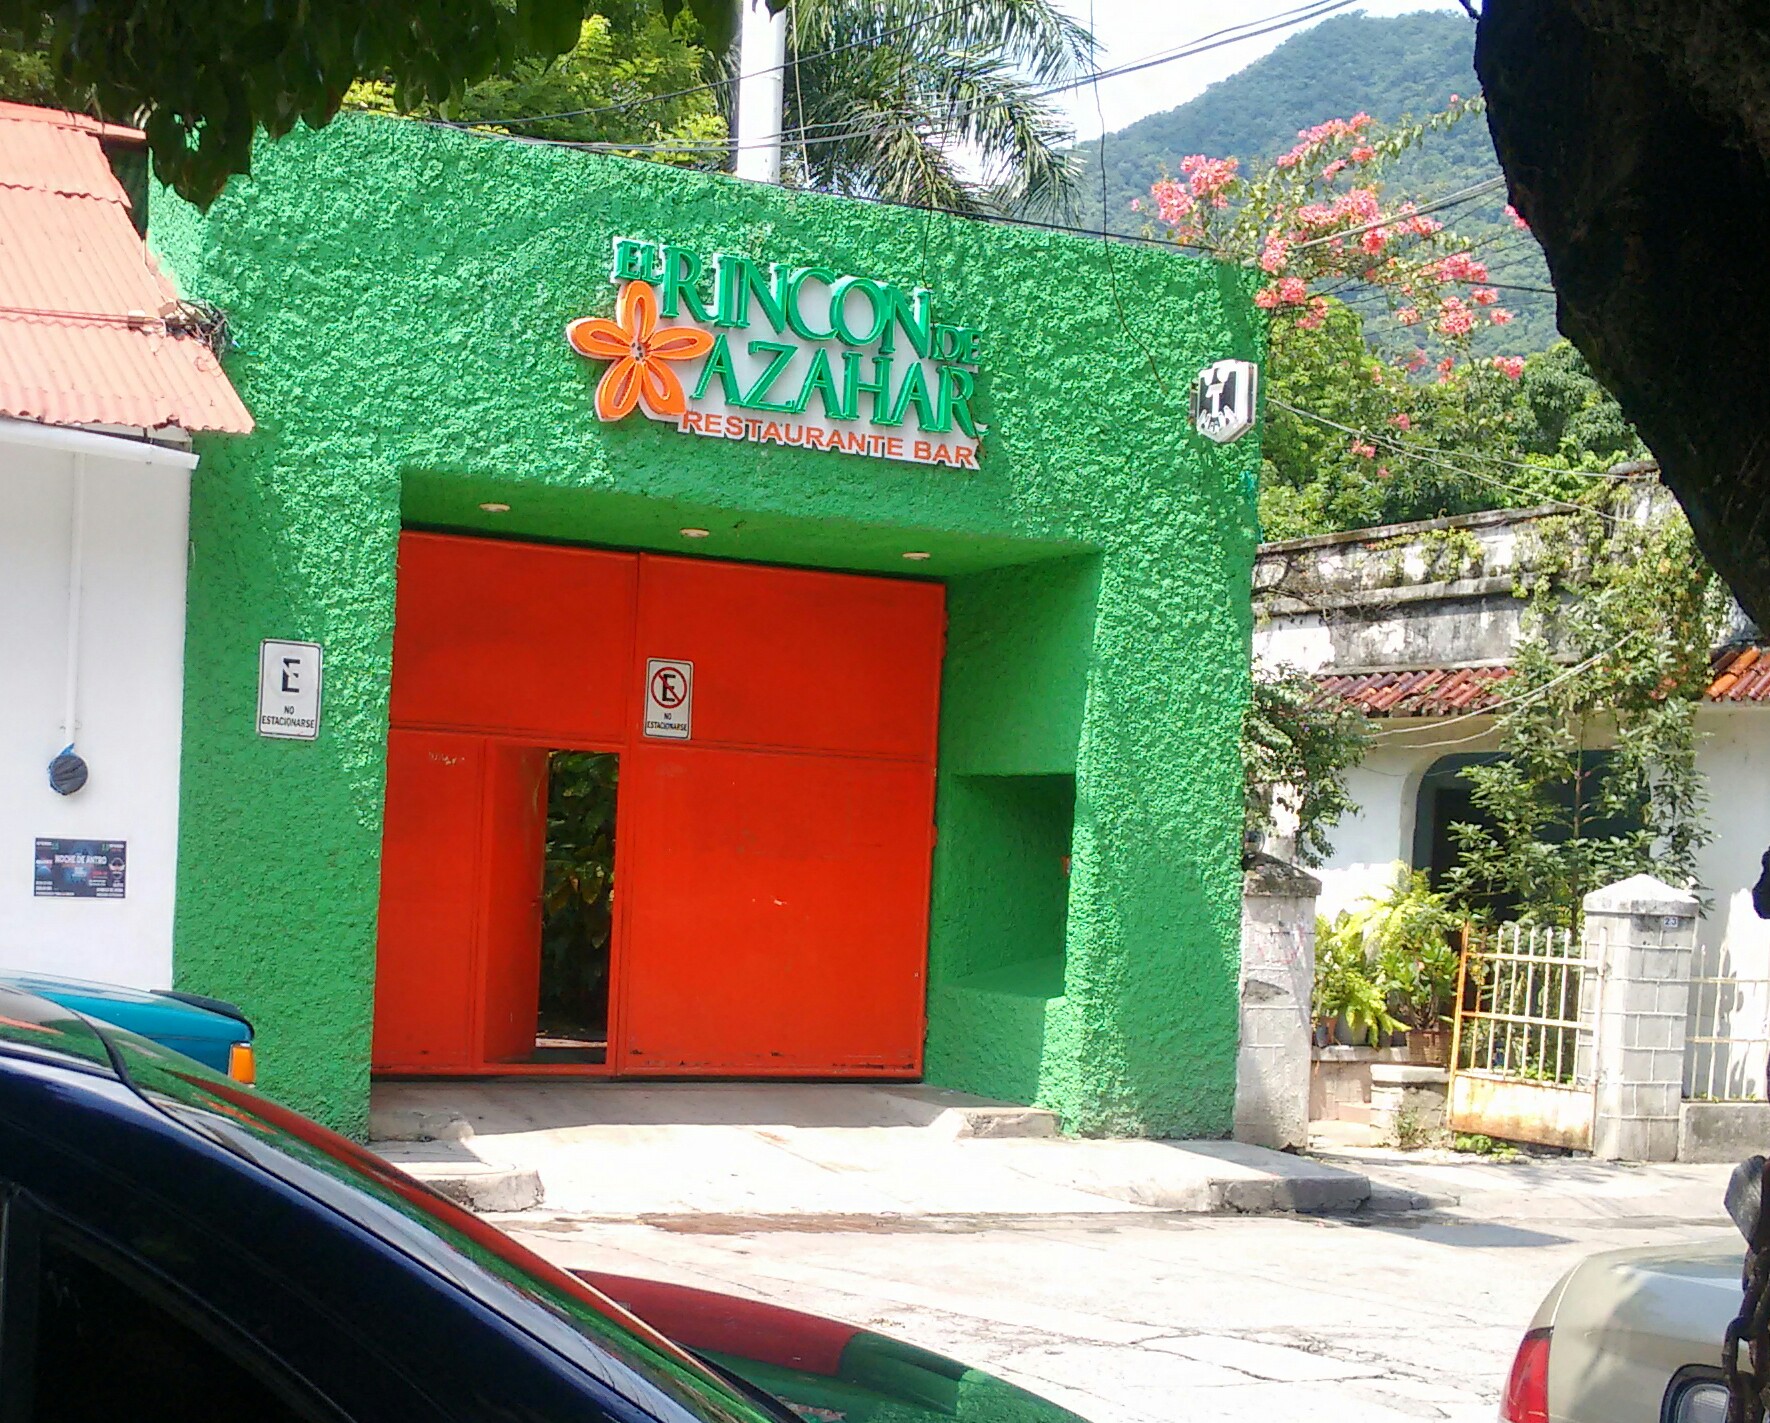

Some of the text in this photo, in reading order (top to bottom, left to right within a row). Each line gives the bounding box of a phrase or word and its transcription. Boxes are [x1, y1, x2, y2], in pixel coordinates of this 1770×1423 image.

[613, 239, 984, 366] EL RINCON DE
[689, 333, 990, 439] AZAHAR
[682, 410, 975, 467] RESTAURANTE BAR
[283, 705, 295, 715] NO
[663, 712, 672, 721] NO
[261, 715, 315, 729] ESTACIONARSE
[647, 720, 688, 732] ESTACIONARSE
